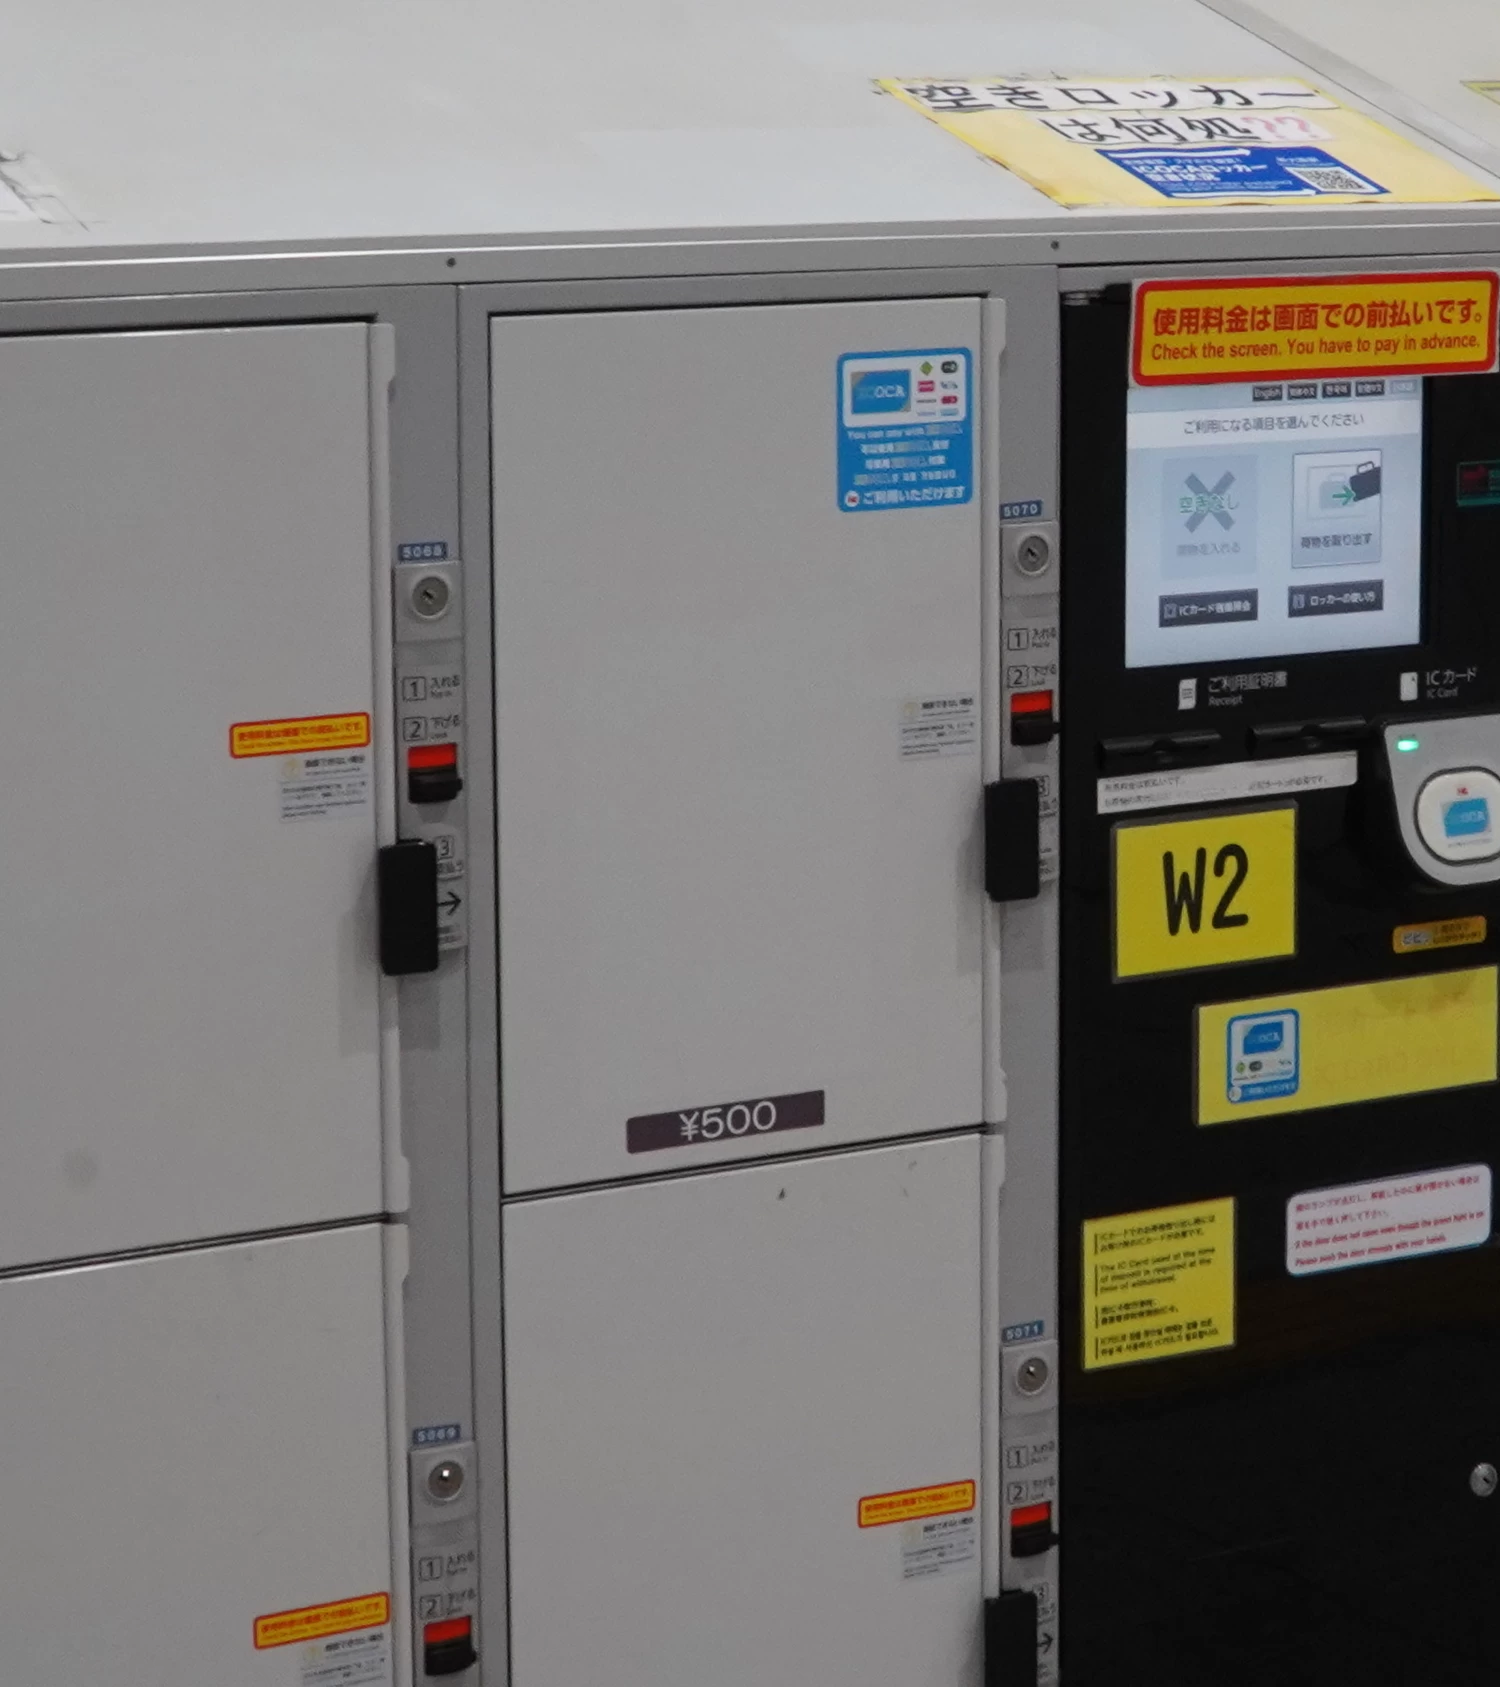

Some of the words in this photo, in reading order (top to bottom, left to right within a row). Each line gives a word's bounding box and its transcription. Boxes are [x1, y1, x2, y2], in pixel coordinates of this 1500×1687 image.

[906, 84, 1317, 111] 空きロッカー
[1153, 298, 1483, 337] 使用料金は画面での前払いです。
[1151, 342, 1198, 361] Check
[1202, 341, 1226, 359] the
[1229, 343, 1282, 358] screen.
[1287, 337, 1315, 355] You
[1319, 337, 1354, 354] have
[1356, 335, 1372, 352] to
[1374, 337, 1400, 357] pay
[1403, 334, 1417, 351] in
[1420, 332, 1481, 350] advance.
[1003, 503, 1039, 518] 5070
[1425, 670, 1441, 687] IC
[1442, 667, 1478, 685] カード
[1161, 842, 1250, 937] W2
[678, 1100, 777, 1142] ¥500
